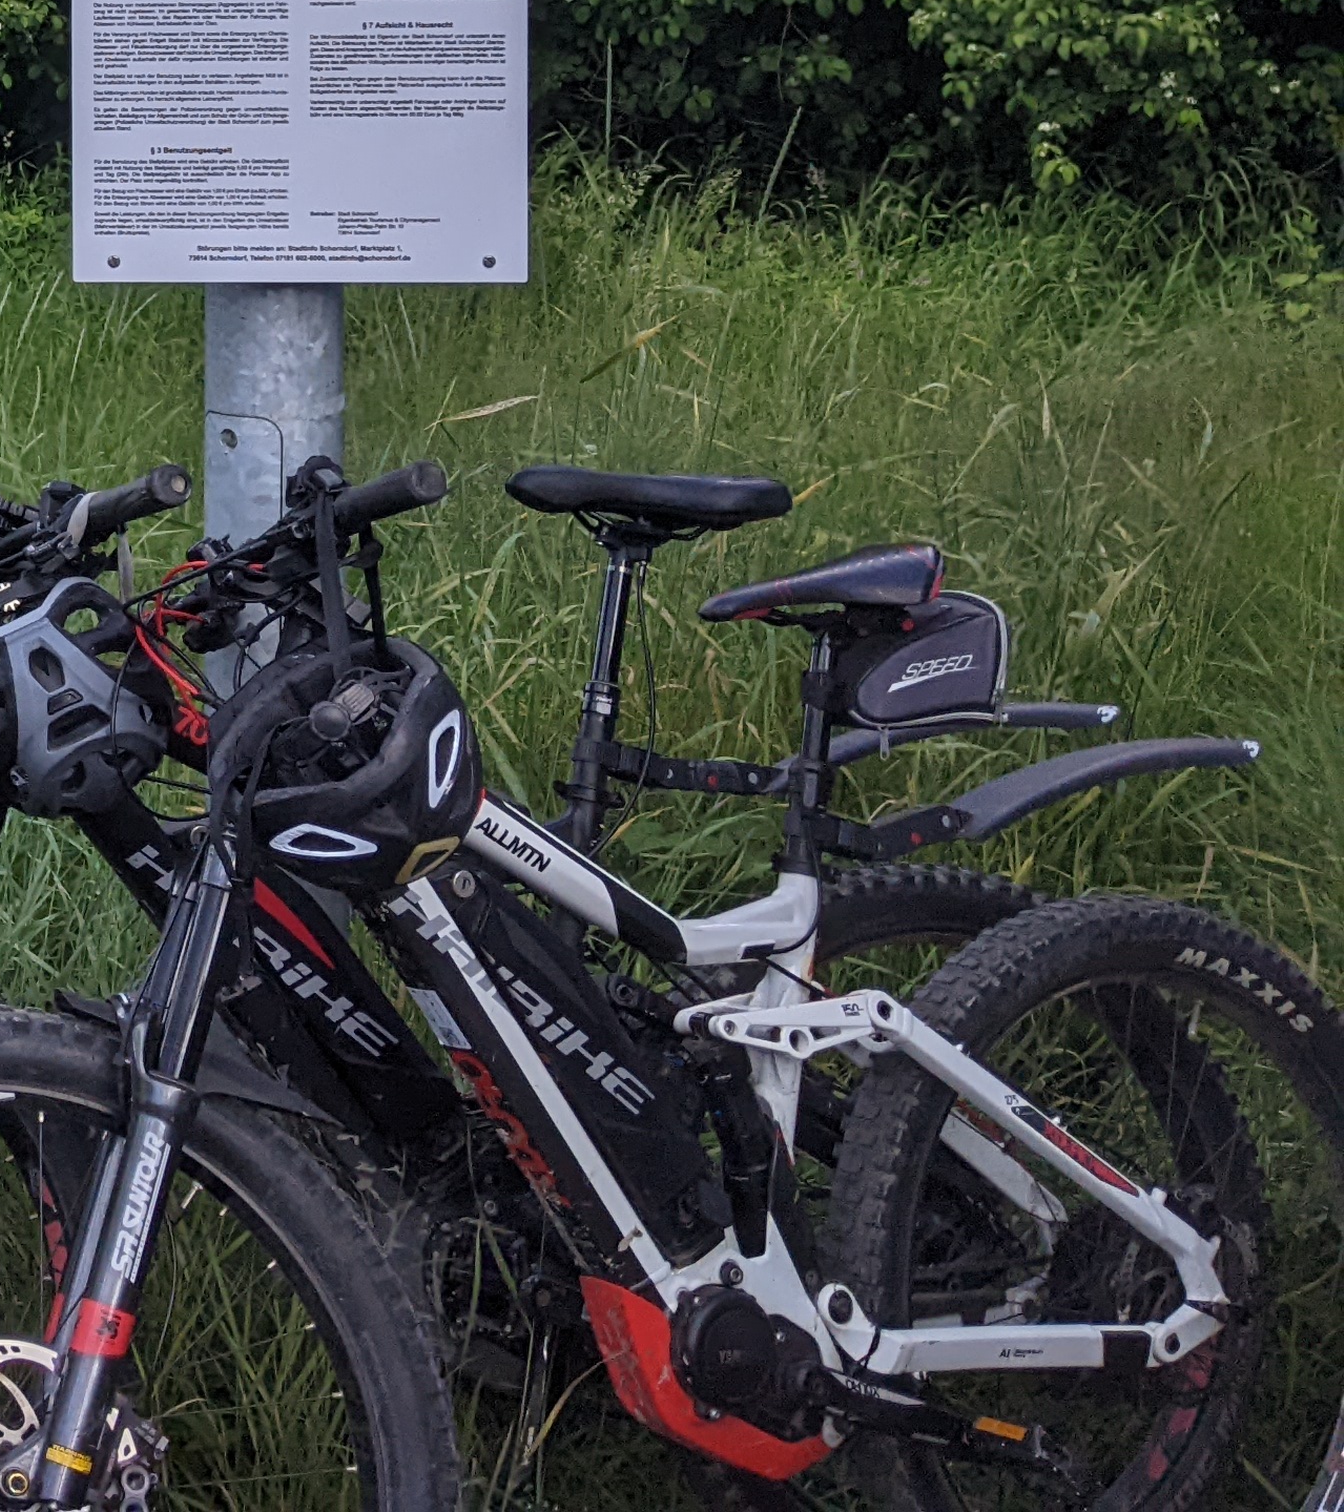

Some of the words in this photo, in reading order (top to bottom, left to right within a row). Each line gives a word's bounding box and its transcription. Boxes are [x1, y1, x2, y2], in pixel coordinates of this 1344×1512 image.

[902, 654, 973, 680] SPEED
[474, 817, 551, 873] ALLMTN
[1174, 946, 1313, 1033] MAXXIS
[122, 1131, 165, 1236] SUNTOUR
